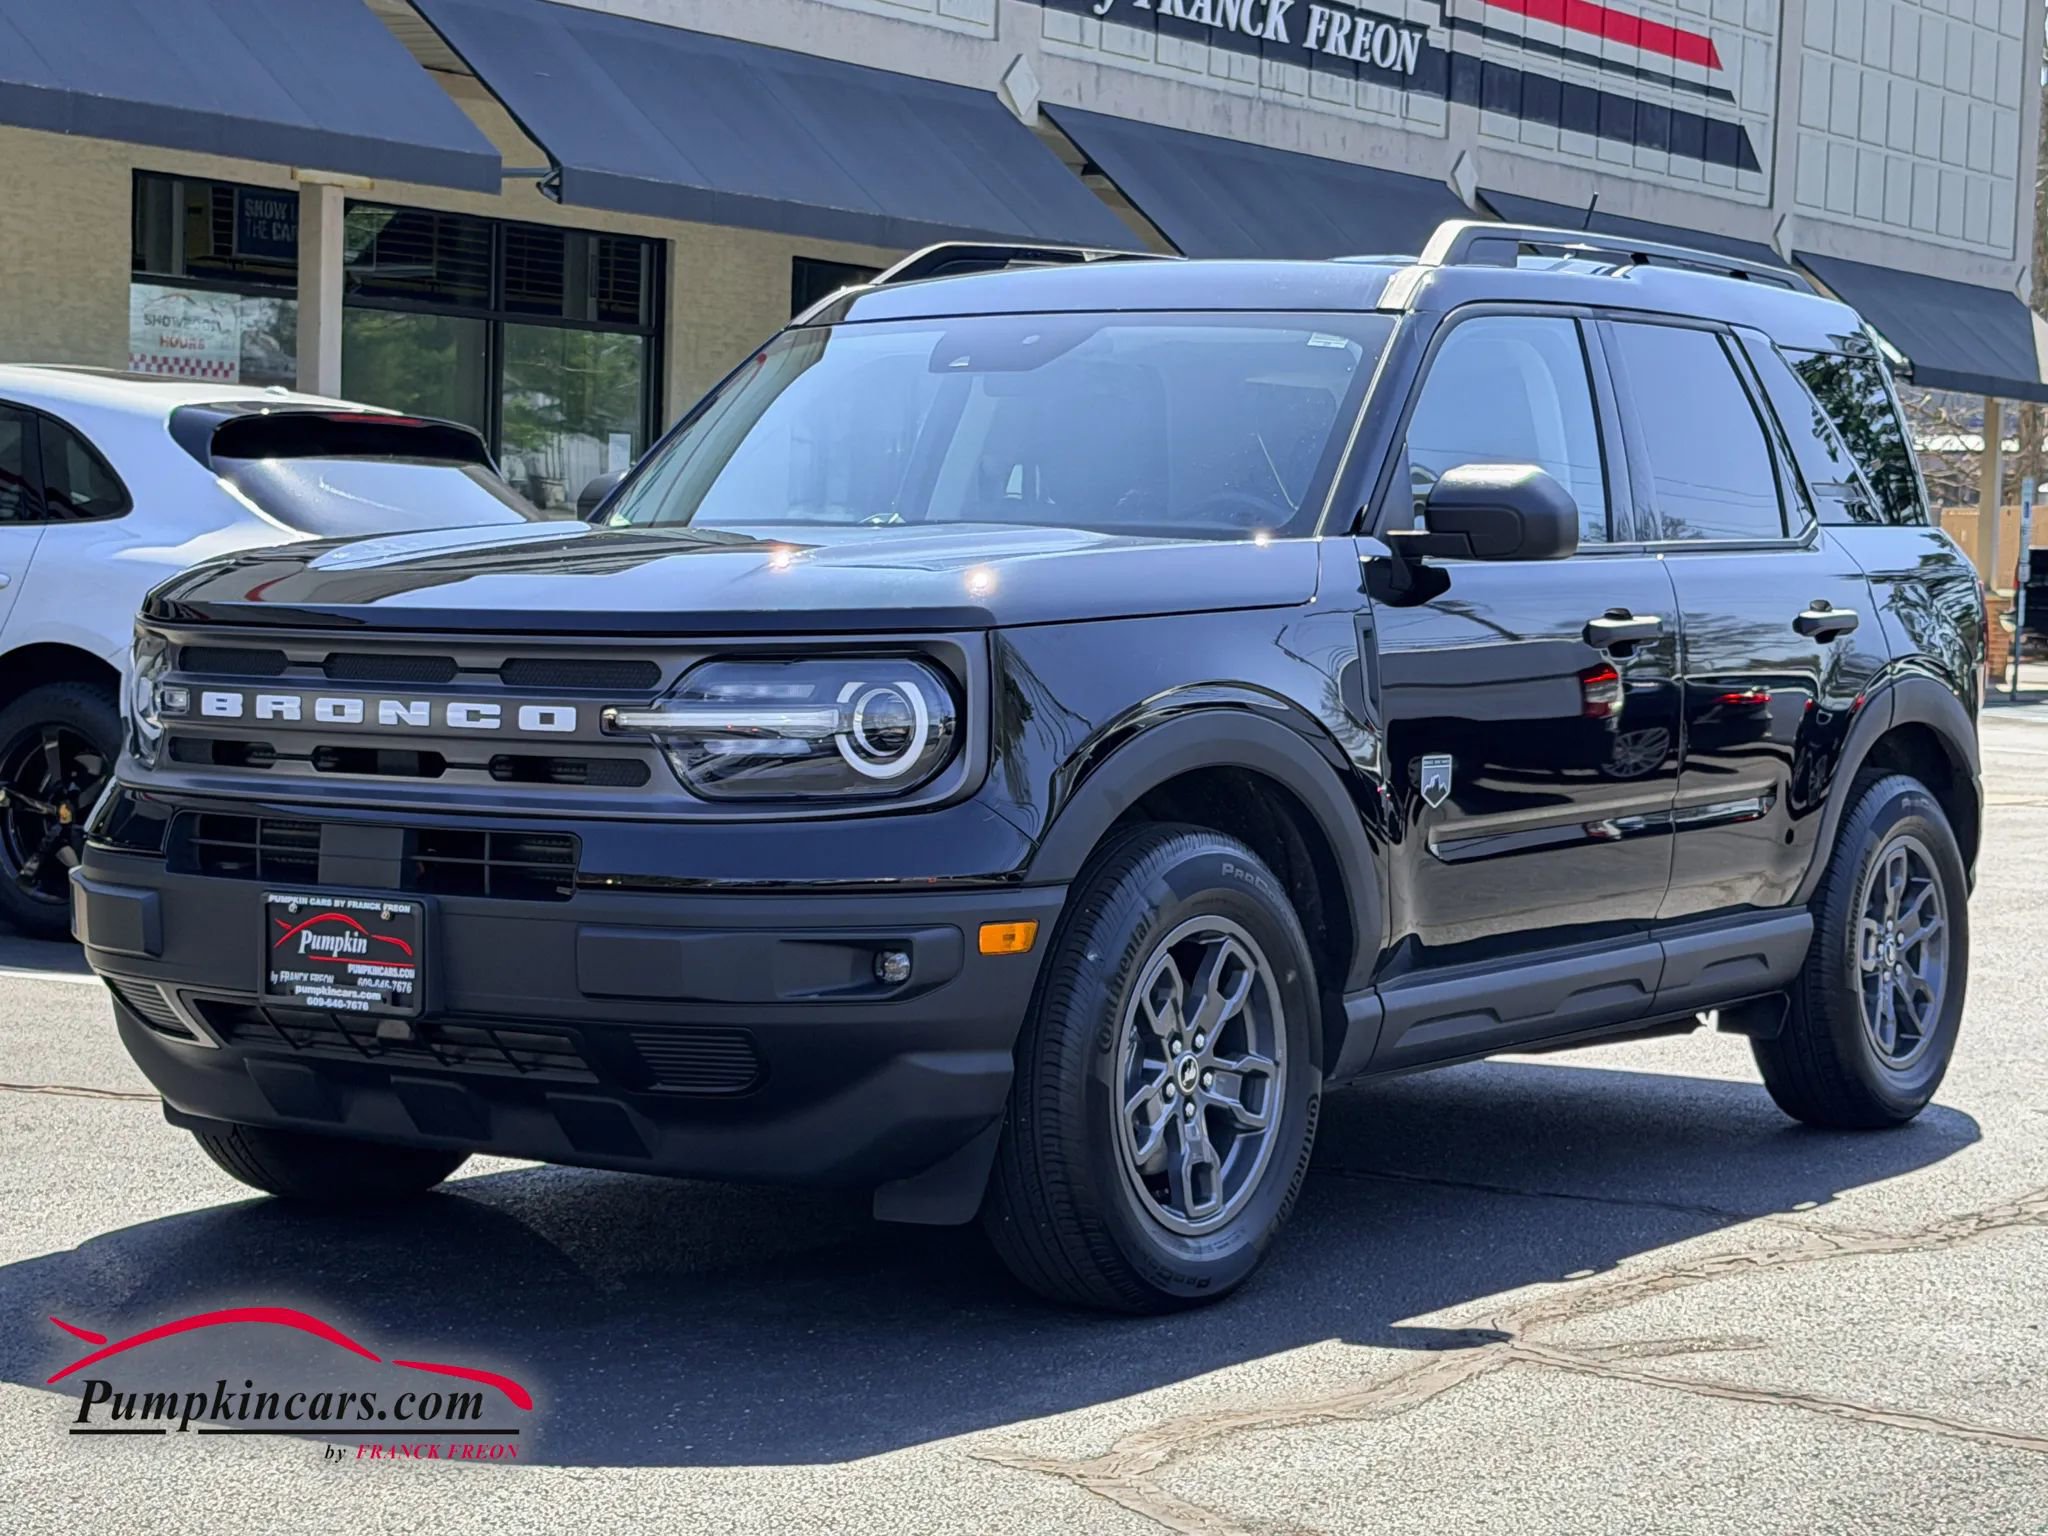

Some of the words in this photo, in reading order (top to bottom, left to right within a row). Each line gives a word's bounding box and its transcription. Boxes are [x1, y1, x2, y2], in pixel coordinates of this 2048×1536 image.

[1302, 4, 1422, 76] FREON
[244, 198, 288, 221] SHOW
[245, 218, 269, 240] THE
[201, 691, 577, 733] BRONCO
[268, 894, 308, 905] PUMPKIN
[309, 897, 332, 907] CARS
[333, 899, 346, 908] BY
[347, 900, 381, 911] FRANCK
[382, 902, 411, 914] FREON
[297, 929, 368, 957] Pumpkin
[347, 963, 416, 979] PUMPKINCARS.COM
[295, 984, 382, 1001] pumpkincars.com
